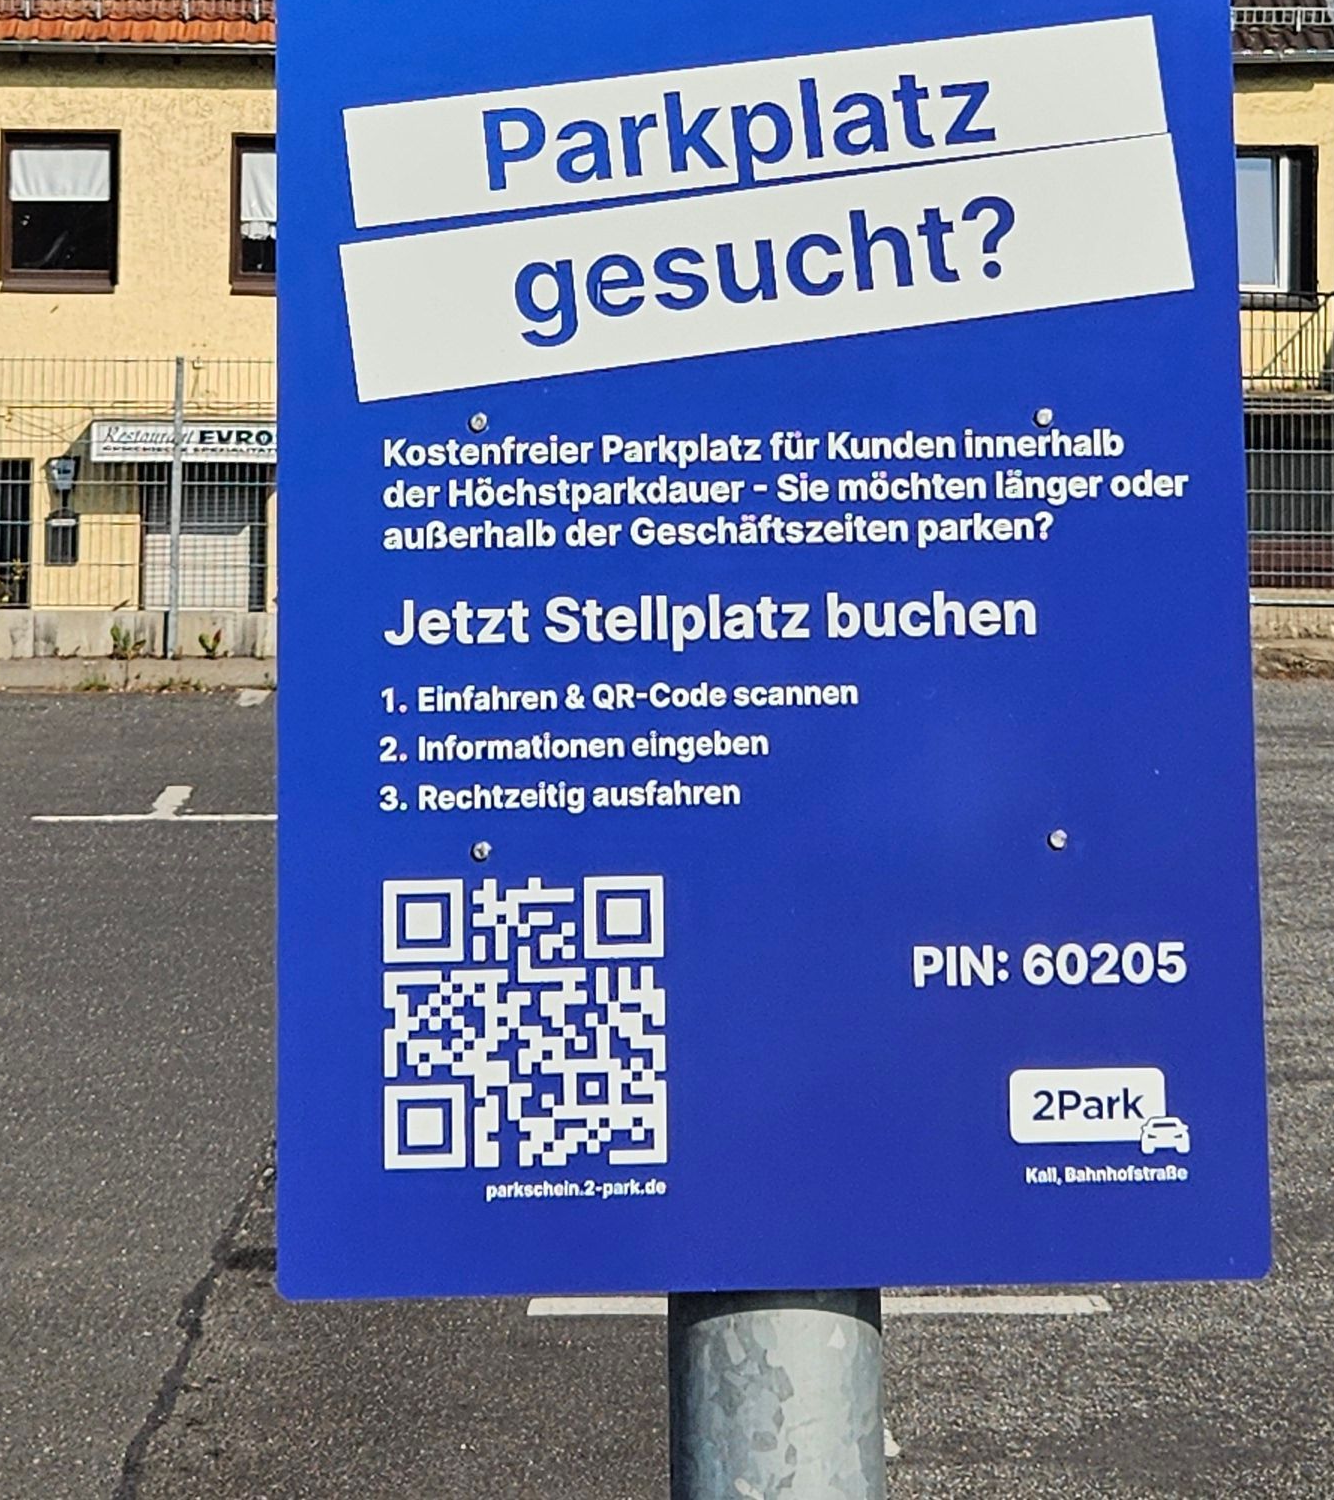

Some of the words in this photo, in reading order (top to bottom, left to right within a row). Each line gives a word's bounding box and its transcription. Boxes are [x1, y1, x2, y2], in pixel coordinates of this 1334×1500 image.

[482, 72, 999, 191] Parkplatz
[514, 198, 1017, 347] gesucht?
[385, 435, 593, 466] Kostenfreier
[602, 434, 761, 468] Parkplatz
[770, 431, 819, 460] für
[828, 431, 956, 459] Kunden
[965, 429, 1124, 457] innerhalb
[384, 480, 440, 507] der
[449, 476, 744, 511] Höchstparkdauer
[778, 473, 828, 501] Sie
[839, 471, 986, 501] möchten
[996, 470, 1103, 505] länger
[1110, 469, 1188, 497] oder
[384, 519, 556, 549] außerhalb
[566, 519, 622, 546] der
[631, 513, 908, 545] Geschäftszeiten
[918, 512, 1053, 548] parken?
[385, 600, 529, 645] Jetzt
[545, 594, 809, 651] Stellplatz
[827, 591, 1036, 637] buchen
[382, 687, 407, 712] 1.
[419, 686, 557, 711] Einfahren
[565, 684, 585, 709] &
[593, 683, 726, 710] QR-Code
[734, 685, 858, 706] scannen
[380, 737, 407, 762] 2.
[419, 732, 624, 761] Informationen
[632, 731, 768, 762] eingeben
[380, 786, 407, 811] 3.
[419, 782, 584, 813] Rechtzeitig
[593, 780, 740, 807] ausfahren
[914, 945, 1008, 987] PIN:
[1023, 942, 1186, 985] 60205
[1033, 1089, 1146, 1124] 2Park
[487, 1179, 666, 1201] parkschein.2-park.de
[1026, 1167, 1062, 1185] Kall,
[1065, 1165, 1188, 1182] Bahnhofstraße
